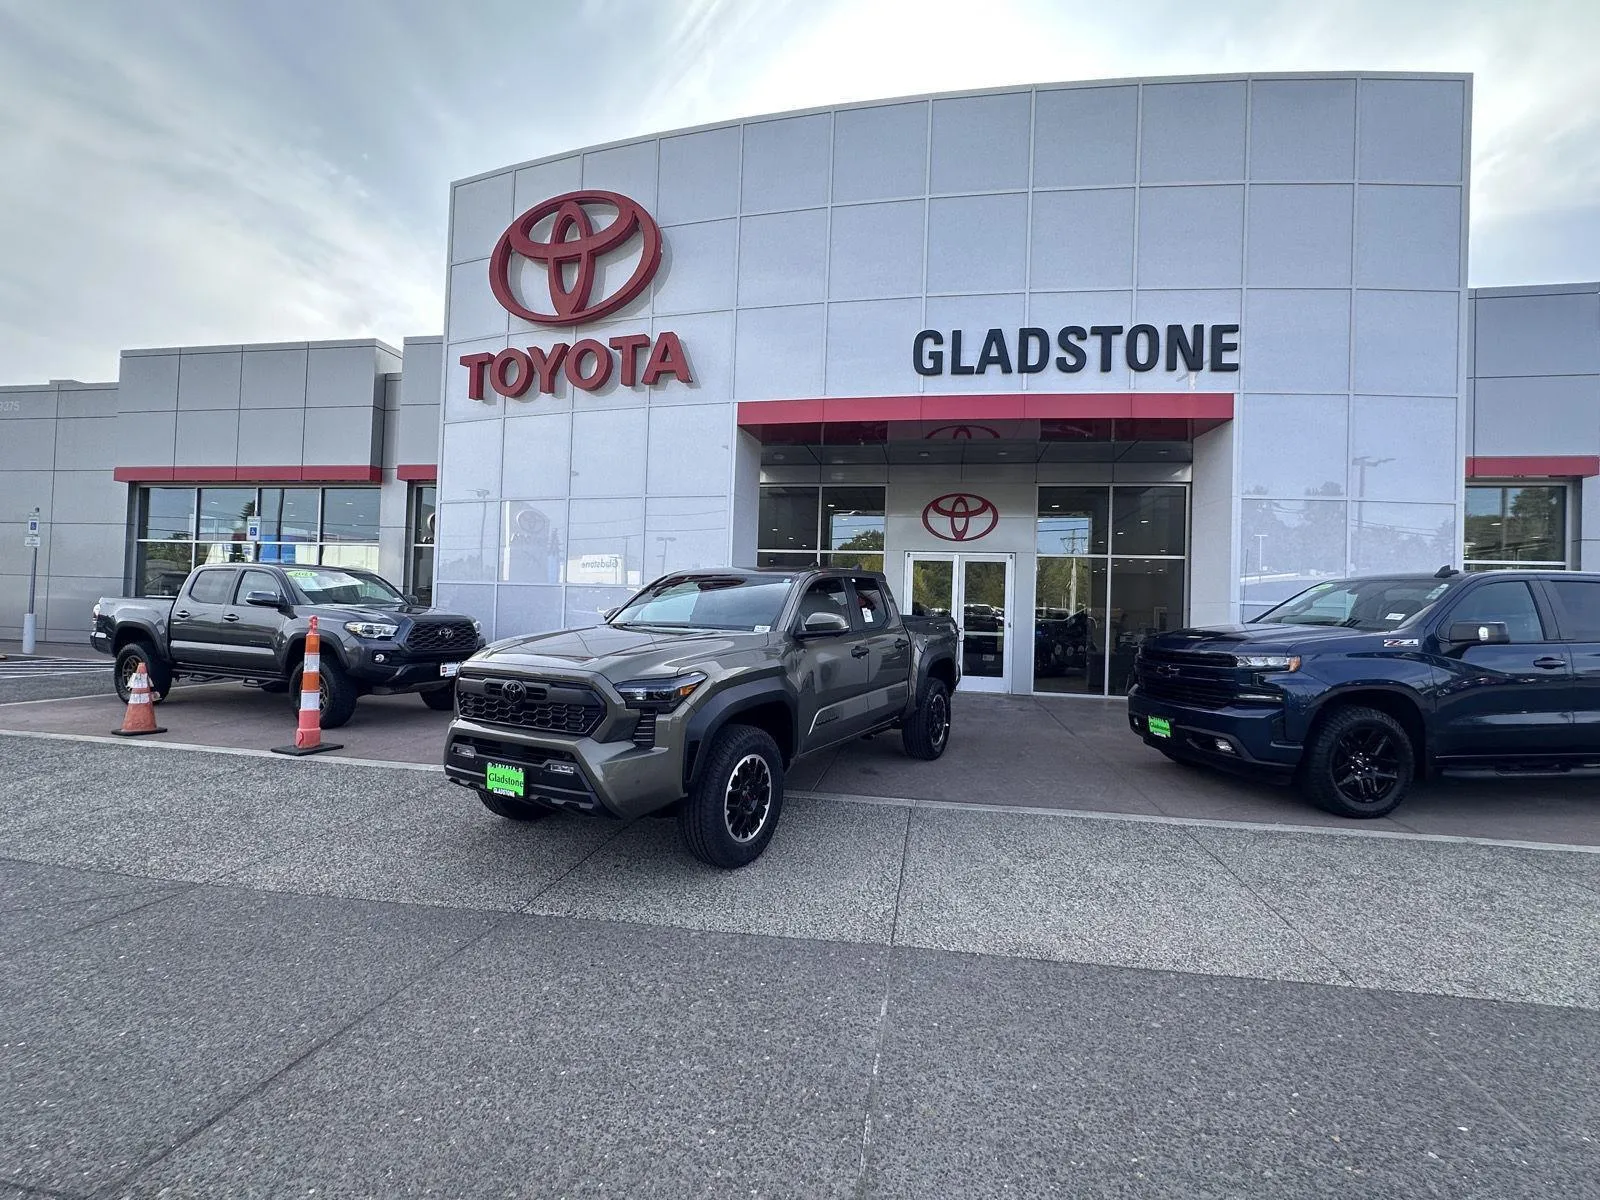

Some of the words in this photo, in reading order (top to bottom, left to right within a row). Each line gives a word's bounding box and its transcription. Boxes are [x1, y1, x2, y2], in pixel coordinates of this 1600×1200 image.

[459, 331, 694, 401] TOYOTA
[913, 323, 1240, 376] GLADSTONE
[488, 773, 524, 788] Gladstone
